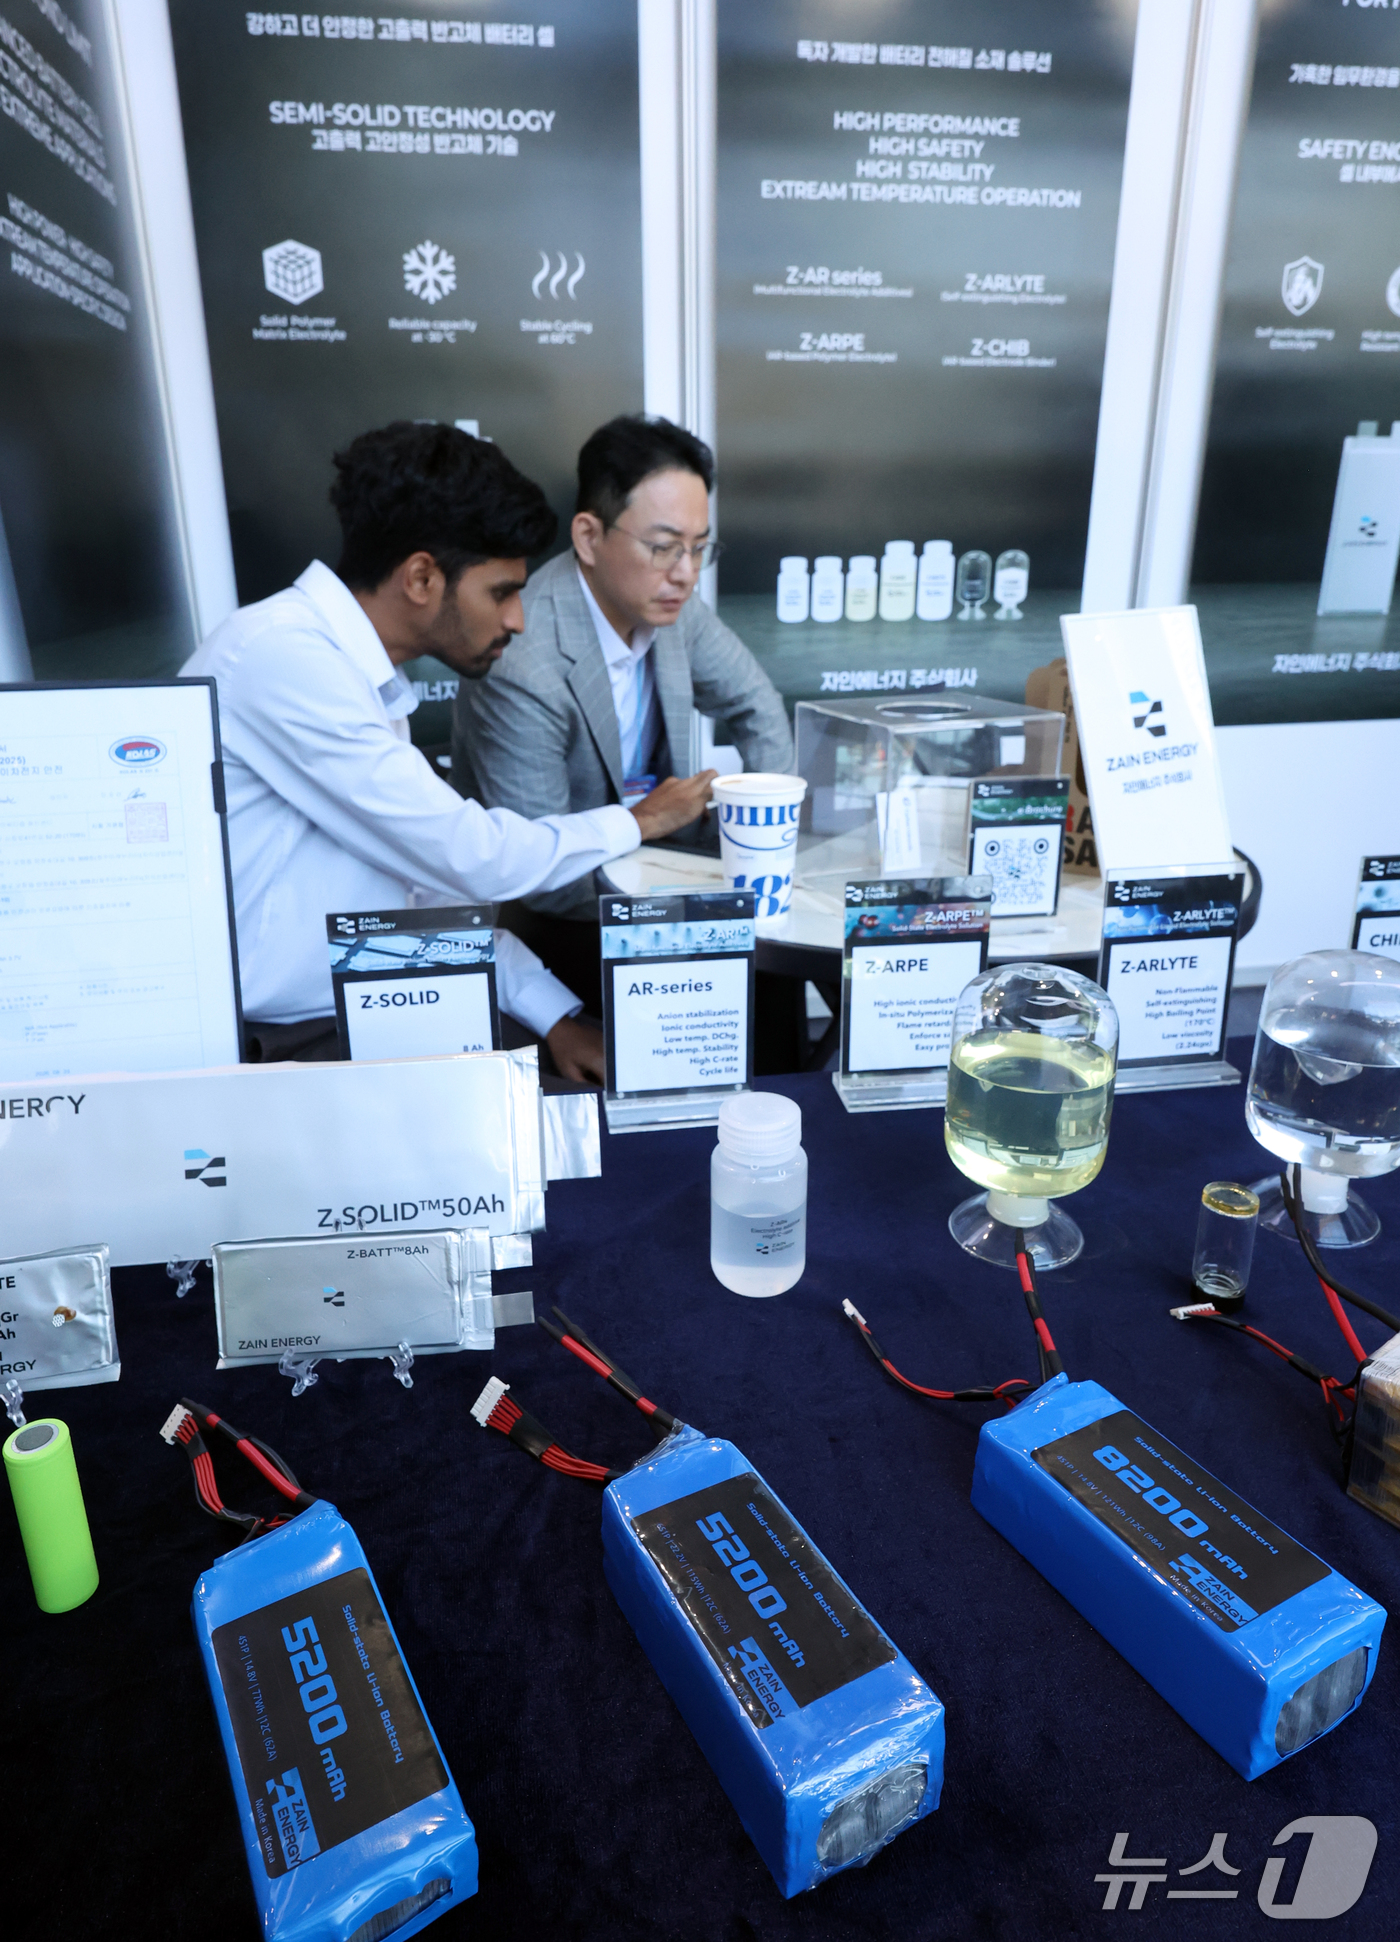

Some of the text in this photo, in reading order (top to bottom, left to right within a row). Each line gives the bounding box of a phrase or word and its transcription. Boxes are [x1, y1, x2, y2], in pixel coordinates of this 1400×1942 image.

[302, 14, 320, 37] 더
[879, 43, 925, 66] 배터리
[1007, 49, 1052, 73] 솔루션
[269, 101, 555, 132] SEMI-SOLID TECHNOLOGY
[833, 111, 1021, 138] HIGH PERFORMANCE
[312, 129, 363, 151] 고출력
[433, 133, 483, 155] 반고체
[485, 134, 519, 157] 기술
[869, 136, 985, 158] HIGH SAFETY
[1297, 138, 1368, 160] SAFETY
[856, 159, 995, 182] HIGH STABILITY
[761, 179, 1082, 208] EXTREAM TEMPERATURE OPERATION
[831, 266, 883, 287] series
[260, 315, 336, 328] Solid Polymer
[820, 669, 906, 692] 자인에너지
[1106, 742, 1200, 773] ZAIN ENERGY
[632, 909, 667, 918] ENERGY
[358, 922, 396, 932] ENERGY
[865, 958, 929, 974] Z-ARPE
[1121, 956, 1199, 974] Z-ARLYTE
[628, 979, 713, 996] AR-series
[360, 990, 440, 1009] Z-SOLID
[873, 998, 917, 1008] High ionic
[657, 1008, 739, 1020] Anion stabilization
[1145, 1007, 1216, 1019] High Boiling Point
[661, 1020, 739, 1032] Ionic conductivity
[897, 1021, 922, 1029] Flame
[909, 1032, 941, 1040] Enforce
[1162, 1029, 1213, 1040] Low viscosity
[471, 1044, 484, 1052] Ah
[664, 1032, 739, 1044] Low temp. DChg.
[915, 1043, 934, 1052] Easy
[652, 1042, 739, 1057] High temp. Stability
[690, 1055, 738, 1066] High C-rate
[699, 1066, 738, 1076] Cycle life
[347, 1245, 429, 1259] Z-BATT™8Ah
[238, 1336, 321, 1350] ZAIN ENERGY
[1134, 1436, 1194, 1486] Solid-state
[1229, 1514, 1279, 1555] Battery
[1092, 1445, 1250, 1580] 8200 mAh
[746, 1502, 790, 1559] Solid-state
[813, 1591, 850, 1638] Battery
[695, 1511, 806, 1668] 5200 mAh
[1169, 1574, 1225, 1622] Made in Korea
[1203, 1575, 1236, 1602] ZAIN
[1195, 1581, 1248, 1625] ENERGY
[342, 1604, 370, 1670] Solid-state
[380, 1709, 405, 1764] Battery
[758, 1663, 783, 1693] ZAIN
[238, 1634, 278, 1762] 4S1P 14.8V 77Wh (62A)
[747, 1669, 786, 1720] ENERGY
[281, 1615, 348, 1802] 5200 mAh
[291, 1798, 310, 1834] ZAIN
[254, 1798, 277, 1864] Made in Korea
[276, 1805, 303, 1866] ENERGY
